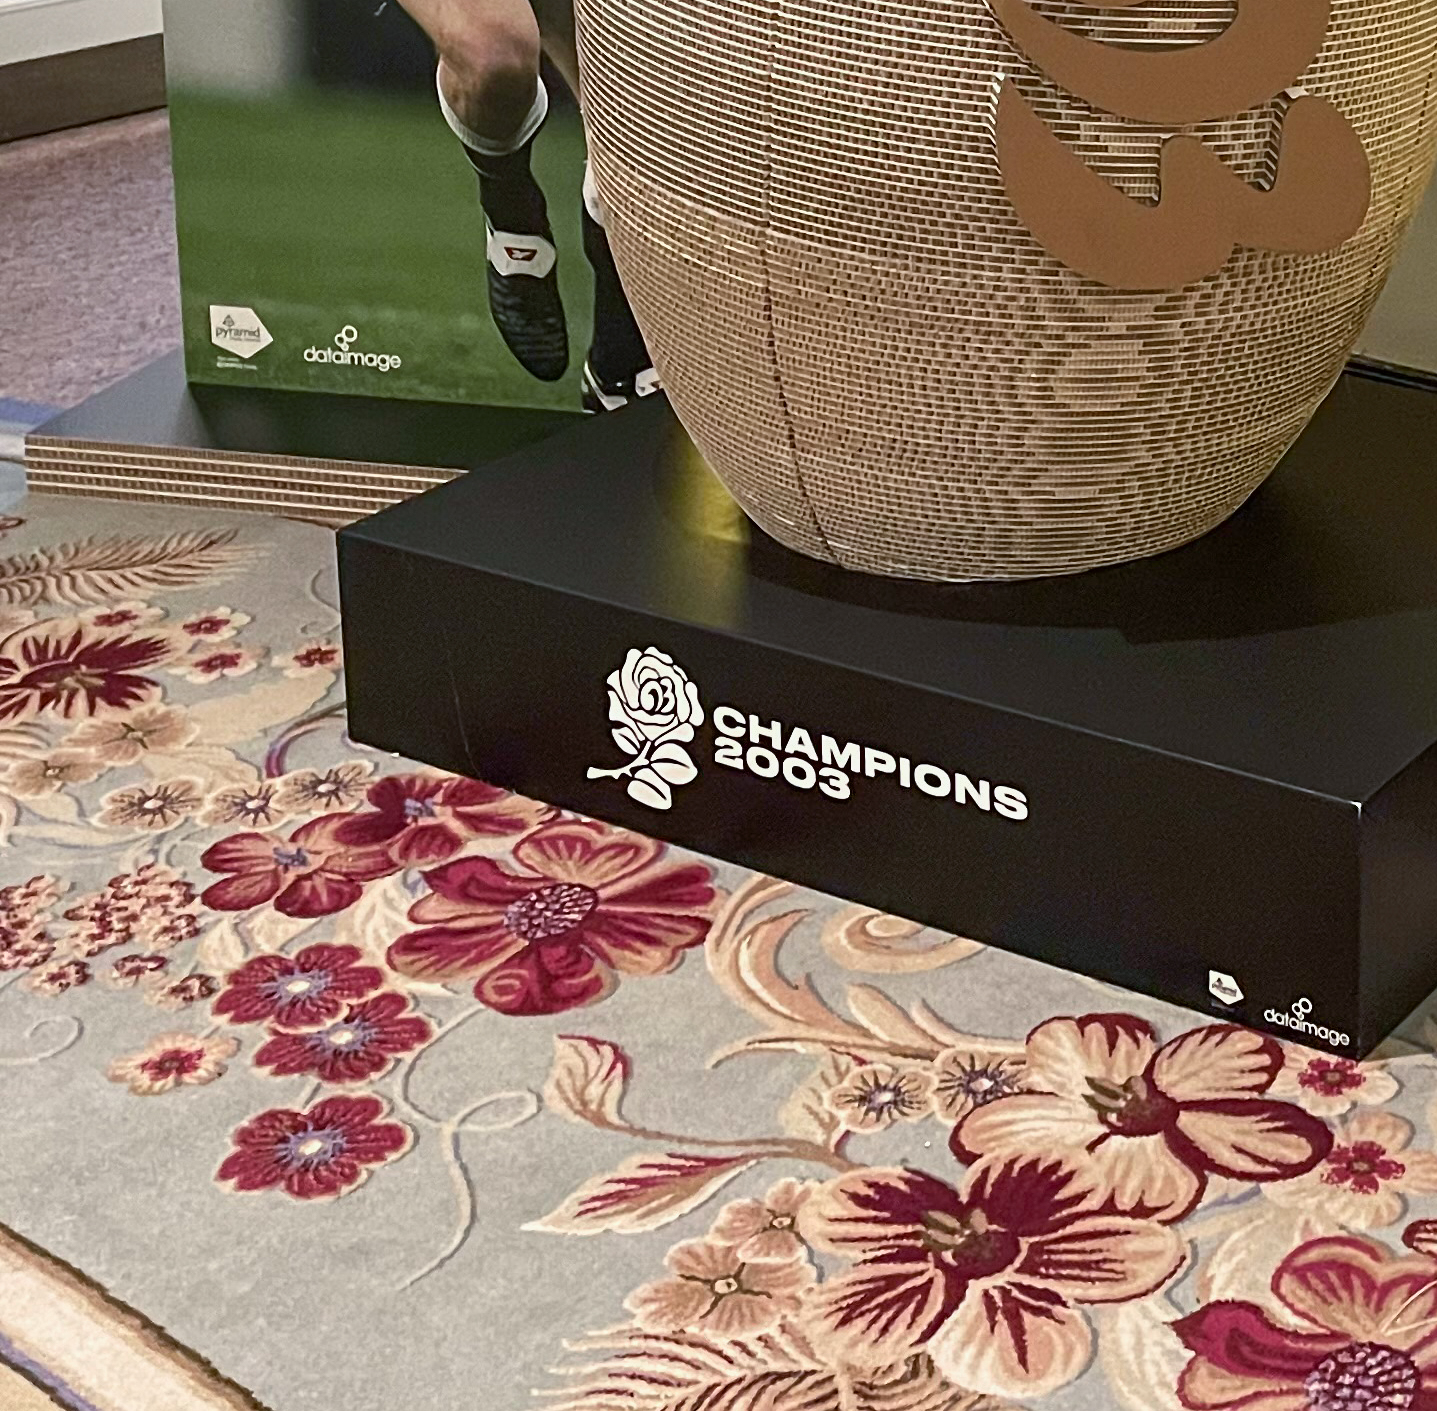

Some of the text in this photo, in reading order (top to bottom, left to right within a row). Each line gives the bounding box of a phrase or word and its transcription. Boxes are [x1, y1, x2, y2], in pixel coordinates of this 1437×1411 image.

[303, 346, 401, 372] dataimage
[713, 706, 1029, 821] CHAMPIONS
[714, 736, 851, 800] 2003
[1263, 1008, 1350, 1046] dataimage
